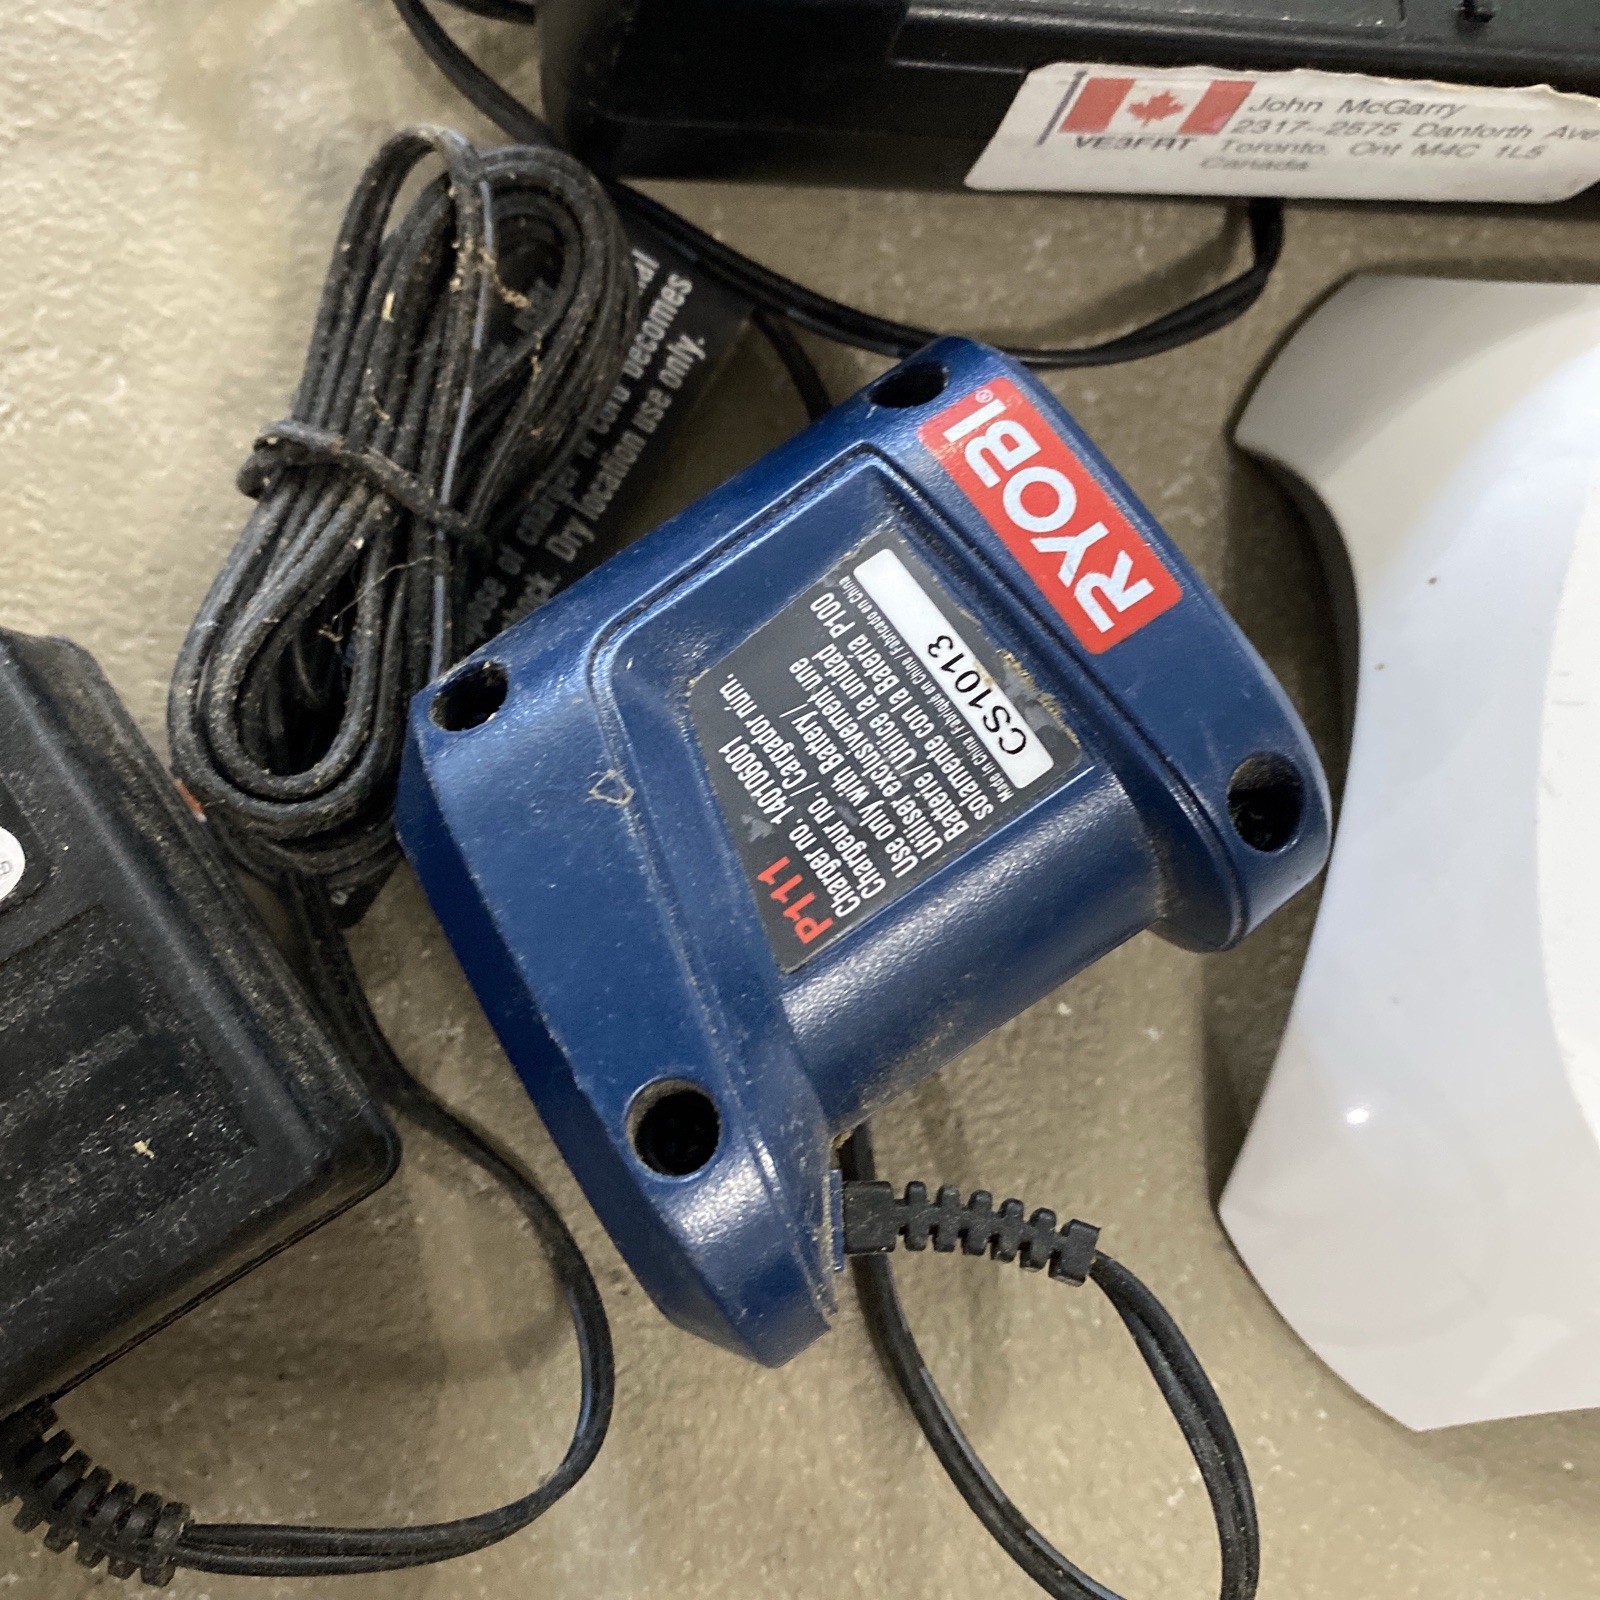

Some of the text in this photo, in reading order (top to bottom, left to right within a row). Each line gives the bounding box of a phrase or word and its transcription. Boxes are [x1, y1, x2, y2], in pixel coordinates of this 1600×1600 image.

[1248, 96, 1467, 120] John McGarry
[1411, 121, 1533, 139] Danforth
[572, 430, 646, 522] location
[631, 387, 673, 433] use
[657, 333, 706, 389] only.
[942, 398, 1155, 633] RYOBI
[838, 575, 864, 604] China
[857, 599, 873, 614] en
[866, 611, 905, 656] Fabricado
[811, 643, 868, 700] unidad
[901, 656, 927, 685] Chine
[920, 680, 937, 696] en
[719, 673, 758, 719] núm.
[809, 592, 994, 821] solamente con la Batería P100
[855, 693, 881, 719] la
[926, 693, 965, 735] Fabriqué
[927, 635, 1027, 755] CS1013
[743, 714, 808, 790] Cargador
[788, 657, 944, 860] Utiliser exclusivement une
[791, 710, 845, 775] Battery
[868, 712, 918, 770] Utilice
[962, 735, 988, 766] China
[831, 765, 870, 807] with
[981, 761, 996, 777] in
[989, 772, 1014, 803] Made
[718, 735, 861, 918] Charger no. 140106001
[807, 791, 836, 825] no.
[857, 799, 896, 841] only
[913, 771, 970, 842] Batterie
[821, 820, 887, 899] Chargeur
[884, 837, 919, 879] Use
[757, 856, 833, 943] P111
